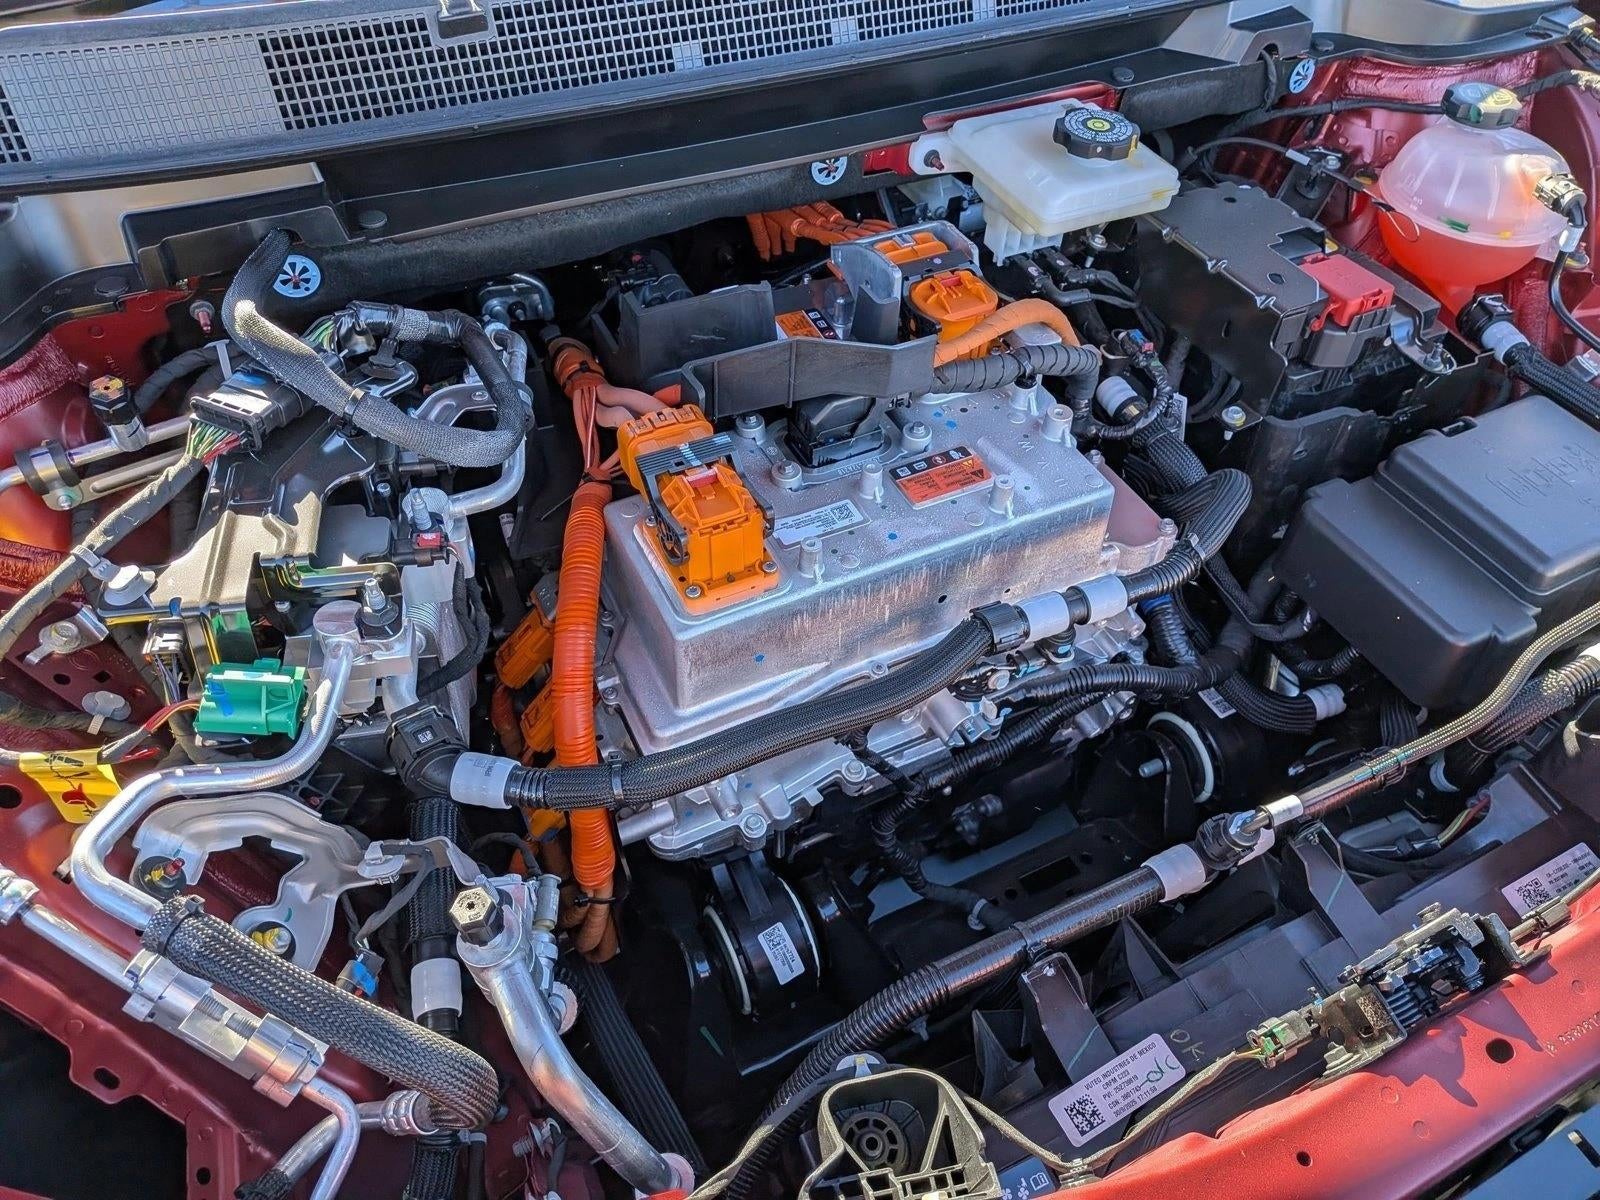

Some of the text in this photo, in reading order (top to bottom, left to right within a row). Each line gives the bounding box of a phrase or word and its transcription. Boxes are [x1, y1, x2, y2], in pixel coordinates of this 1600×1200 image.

[1100, 1060, 1131, 1081] INDUSTRIES
[1129, 1053, 1138, 1062] DE
[1137, 1041, 1157, 1057] MEXICO
